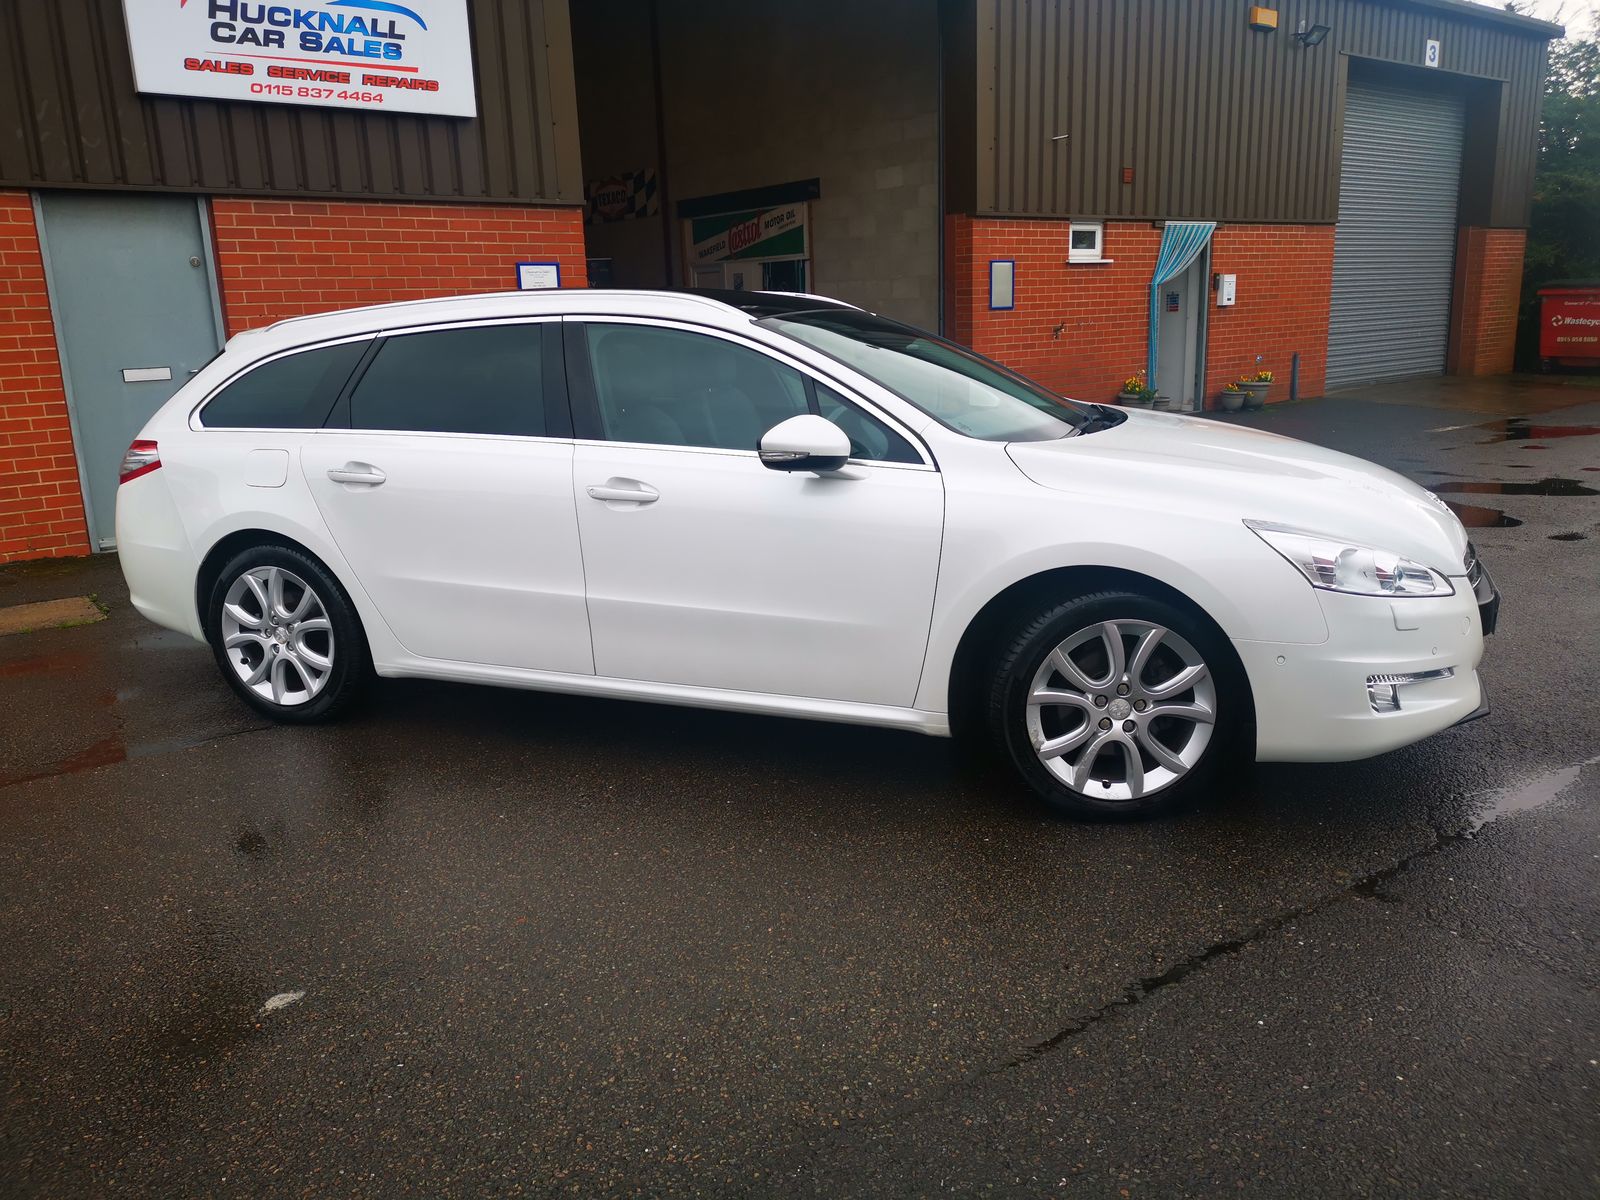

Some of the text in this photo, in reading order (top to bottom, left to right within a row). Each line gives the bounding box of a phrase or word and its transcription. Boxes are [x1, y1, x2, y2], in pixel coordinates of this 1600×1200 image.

[207, 0, 406, 41] HUCKNALL
[210, 21, 402, 60] CAR SALES
[1429, 45, 1436, 62] 3
[184, 57, 440, 92] SALES SERVICE REPAIRS
[251, 83, 384, 104] 0115 837 4464
[764, 214, 786, 230] MOTOR
[785, 209, 796, 222] OIL
